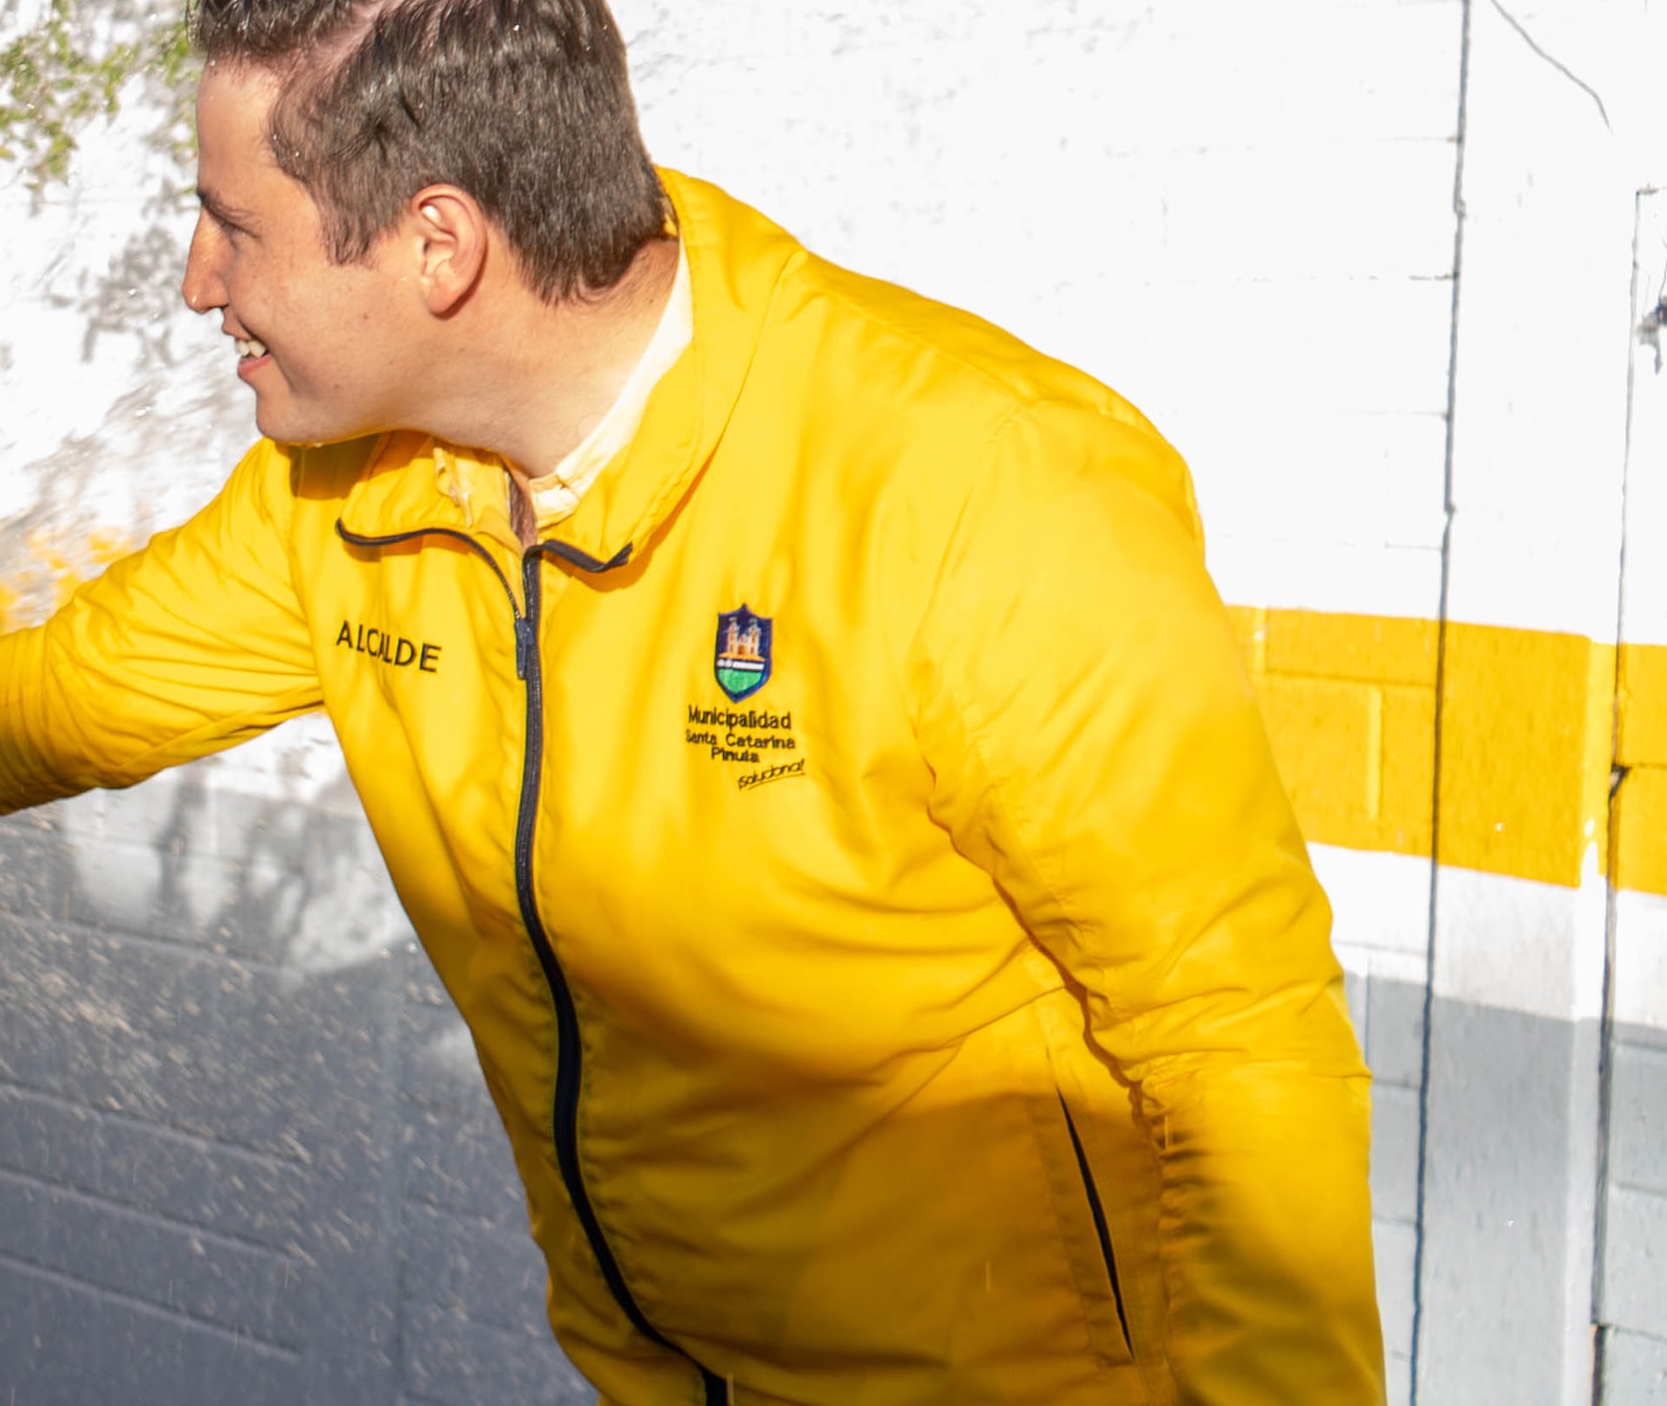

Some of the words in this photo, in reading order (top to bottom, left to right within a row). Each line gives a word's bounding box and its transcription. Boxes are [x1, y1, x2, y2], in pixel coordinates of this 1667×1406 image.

[687, 703, 793, 733] Municipalidad
[685, 728, 718, 746] Santa
[725, 732, 796, 750] Catarina
[710, 746, 761, 763] Pinula
